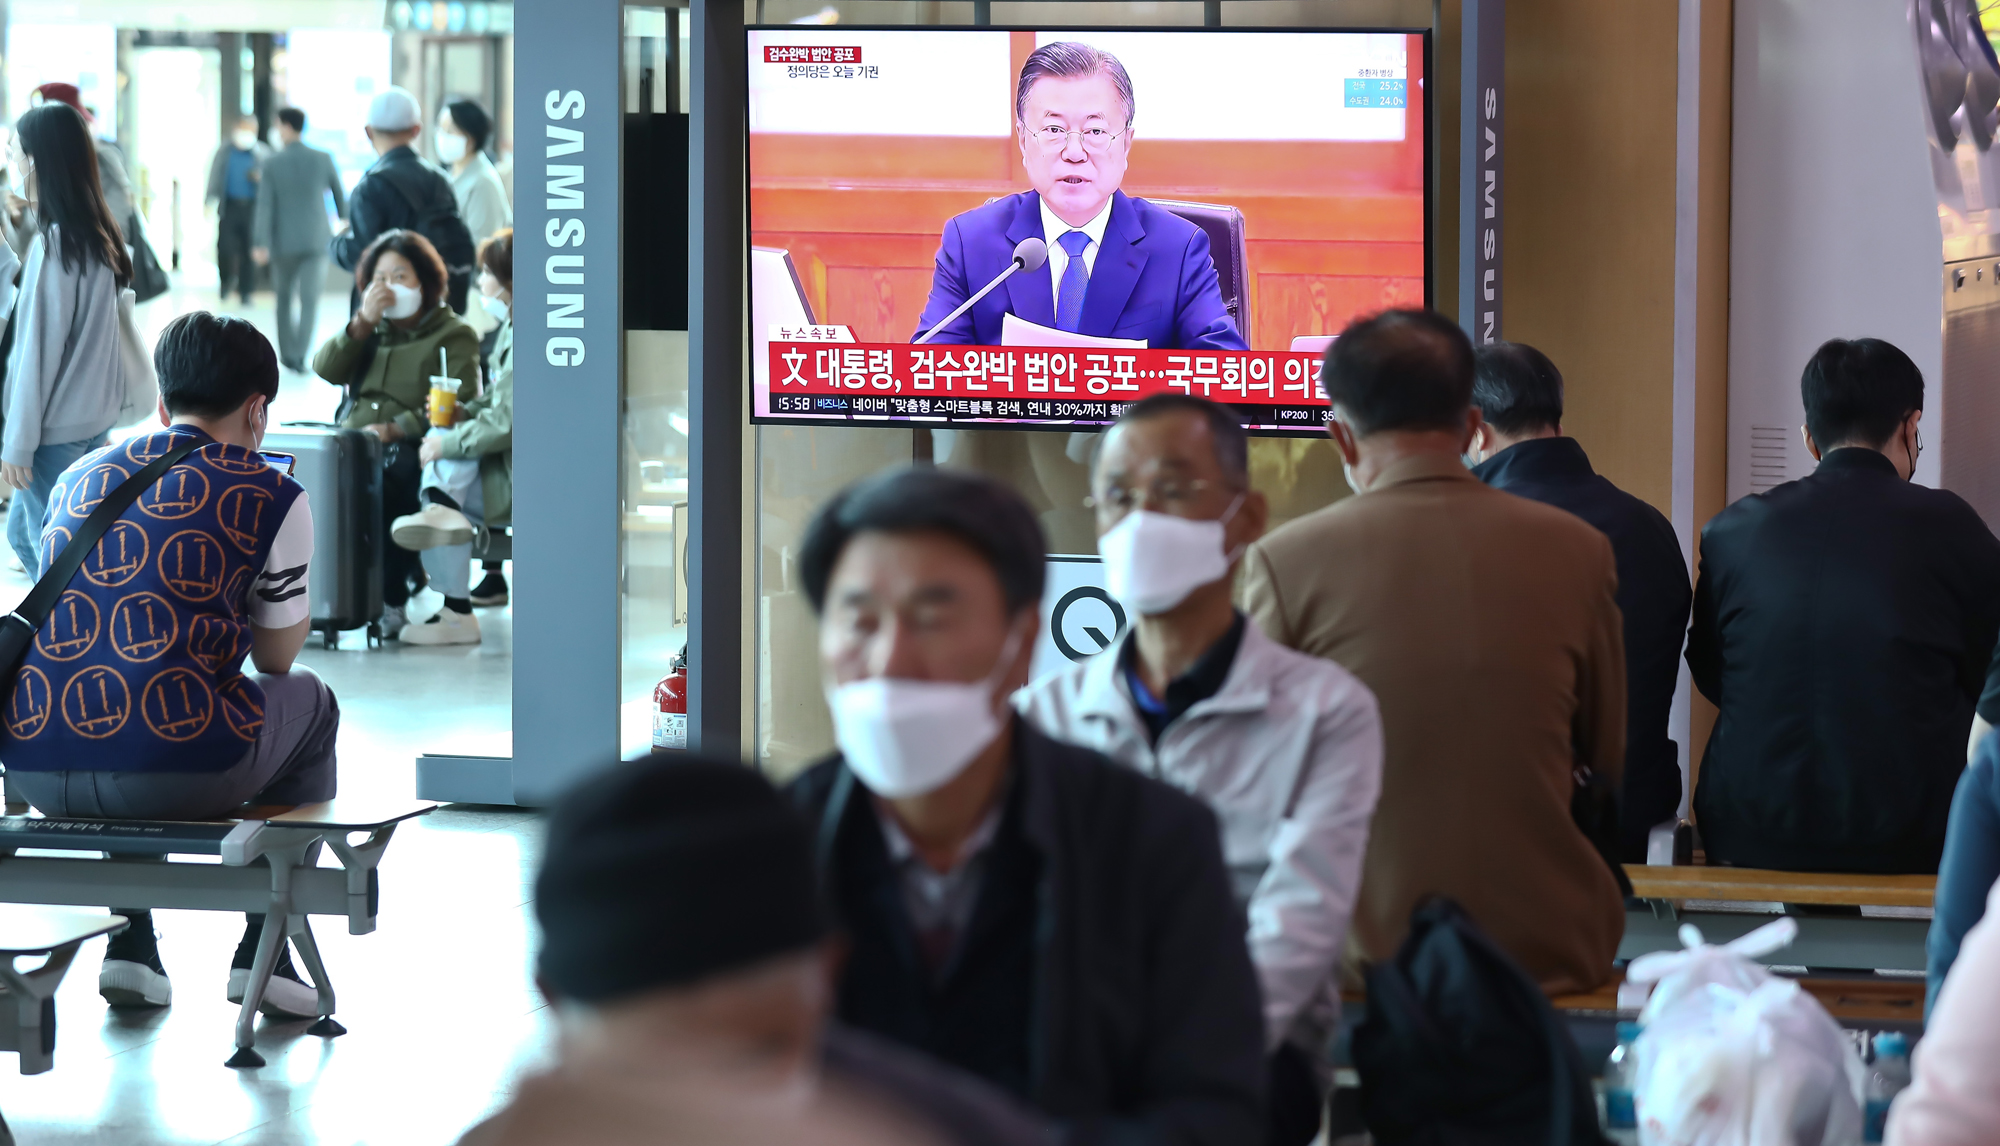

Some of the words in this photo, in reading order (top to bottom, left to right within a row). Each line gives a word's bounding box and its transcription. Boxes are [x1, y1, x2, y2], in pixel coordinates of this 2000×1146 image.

[769, 47, 810, 62] 검수완박
[811, 48, 832, 62] 법안
[834, 48, 855, 62] 공포
[787, 65, 830, 79] 정의당은
[833, 66, 854, 79] 오늘
[857, 66, 879, 79] 기권
[1379, 81, 1404, 91] 25.2%
[1379, 96, 1404, 106] 24.0%
[1484, 87, 1497, 345] SAMSUN
[545, 89, 586, 367] SAMSUNG
[780, 327, 838, 340] 뉴스속보
[781, 347, 808, 387] 文
[816, 348, 902, 393] 대통령,
[909, 350, 1017, 392] 검수완박
[1024, 352, 1078, 393] 법안
[778, 397, 810, 410] 15:58
[817, 398, 849, 410] 비즈니스
[852, 398, 888, 412] 네이버
[933, 400, 993, 415] 스마트블록
[996, 401, 1024, 416] 검색,
[1027, 402, 1051, 416] 연내
[1053, 402, 1107, 418] 30%까지
[1281, 410, 1309, 421] KP200
[1321, 410, 1337, 422] 35
